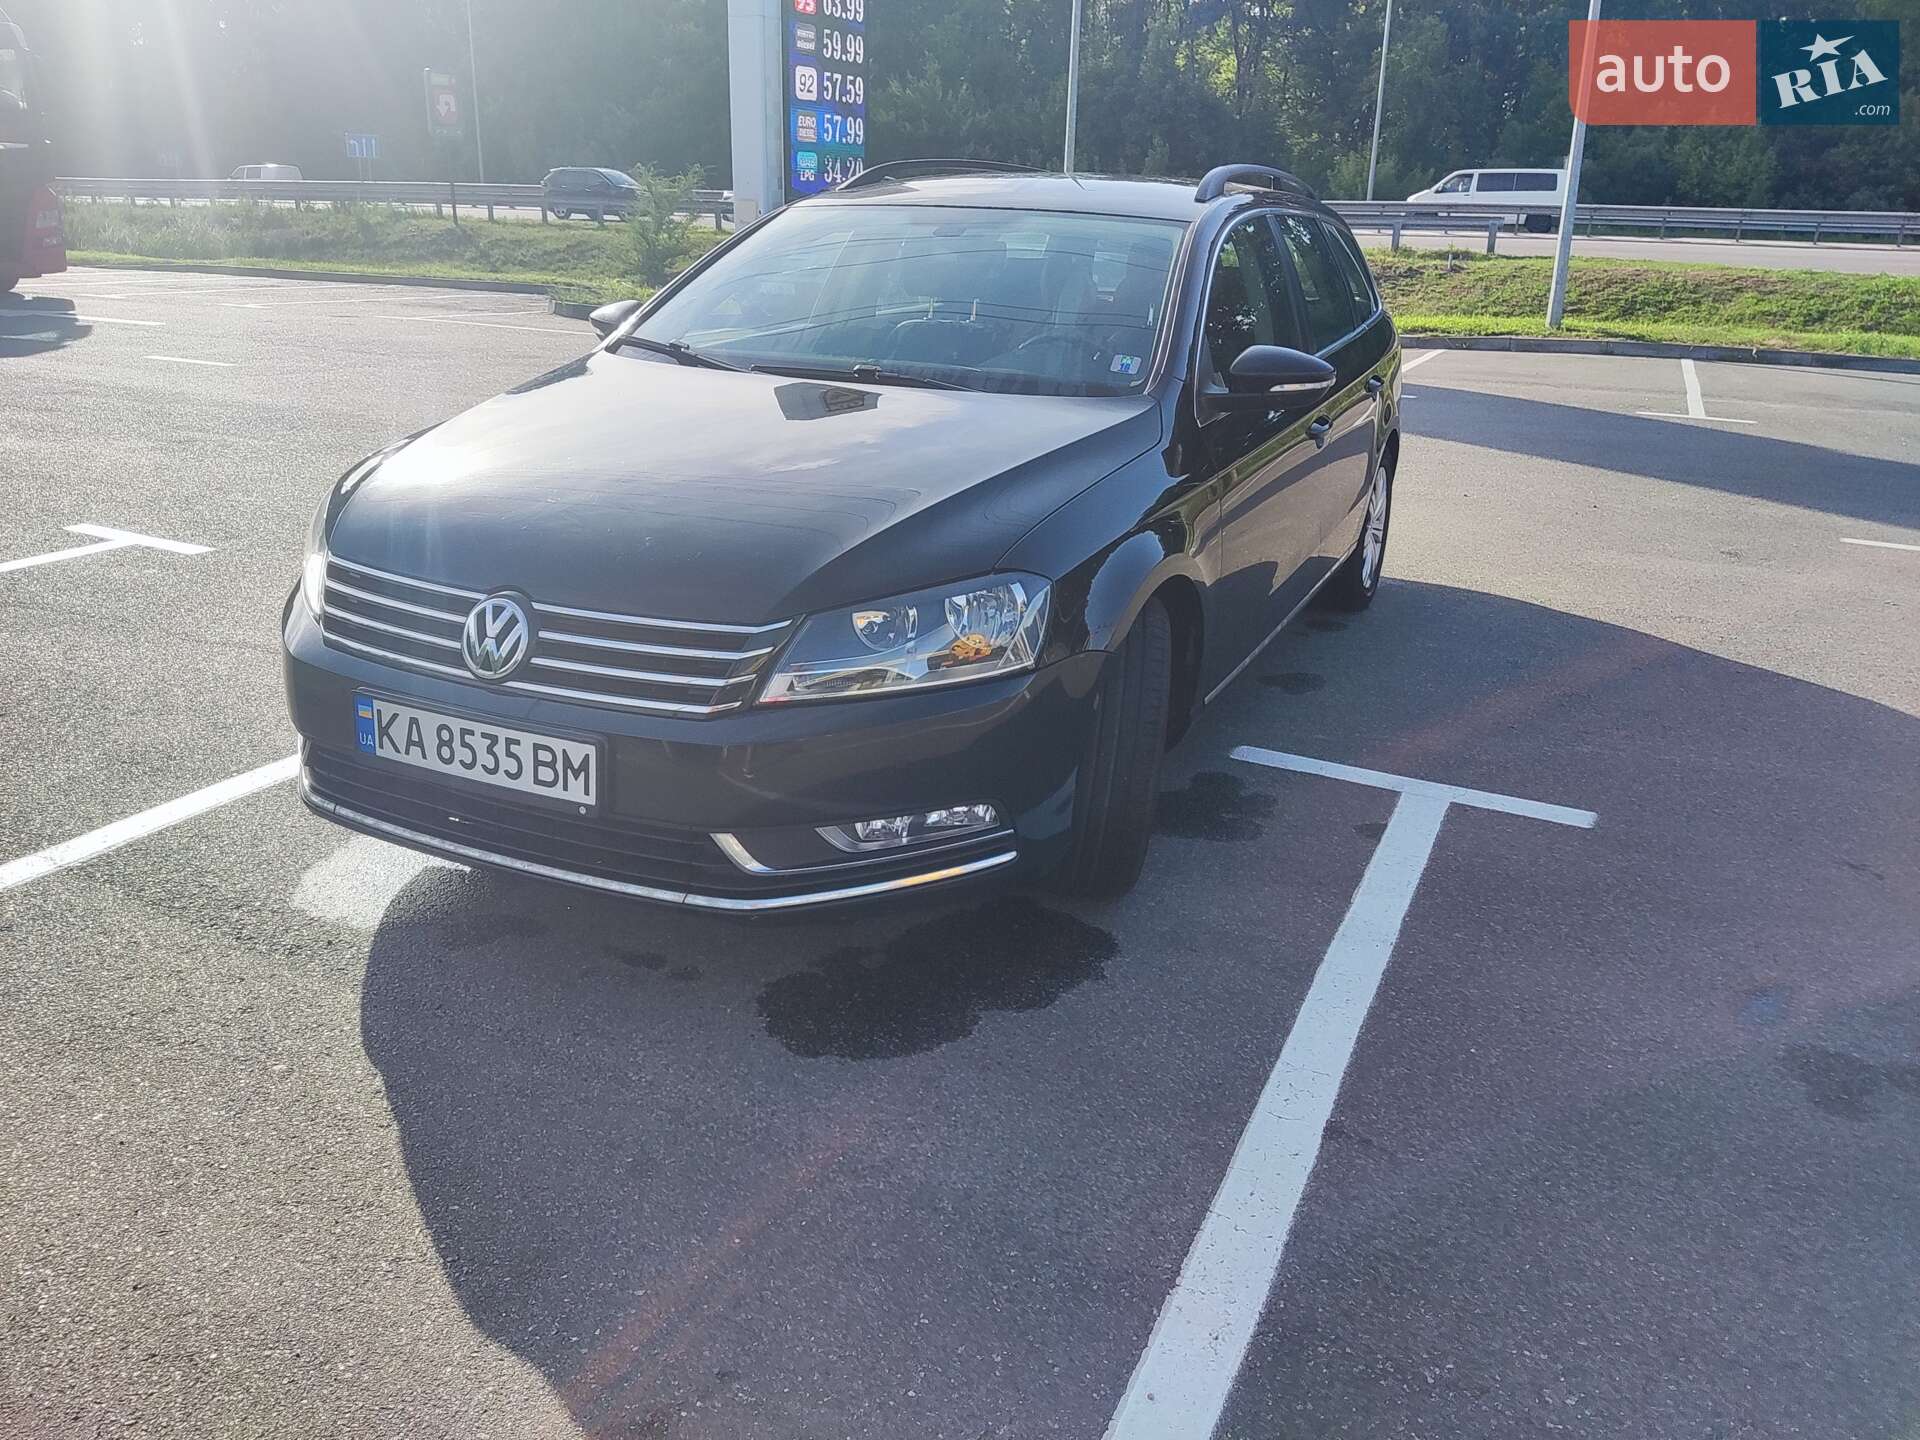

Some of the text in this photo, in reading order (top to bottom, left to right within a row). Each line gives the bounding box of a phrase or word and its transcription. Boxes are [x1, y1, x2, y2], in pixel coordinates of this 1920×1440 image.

[823, 29, 864, 64] 59.99
[799, 71, 864, 105] 92 57.59
[823, 113, 864, 144] 57.99
[799, 169, 815, 181] LPG
[824, 154, 864, 183] 34.20
[359, 731, 374, 747] UA
[376, 708, 590, 797] KA 8535 BM
